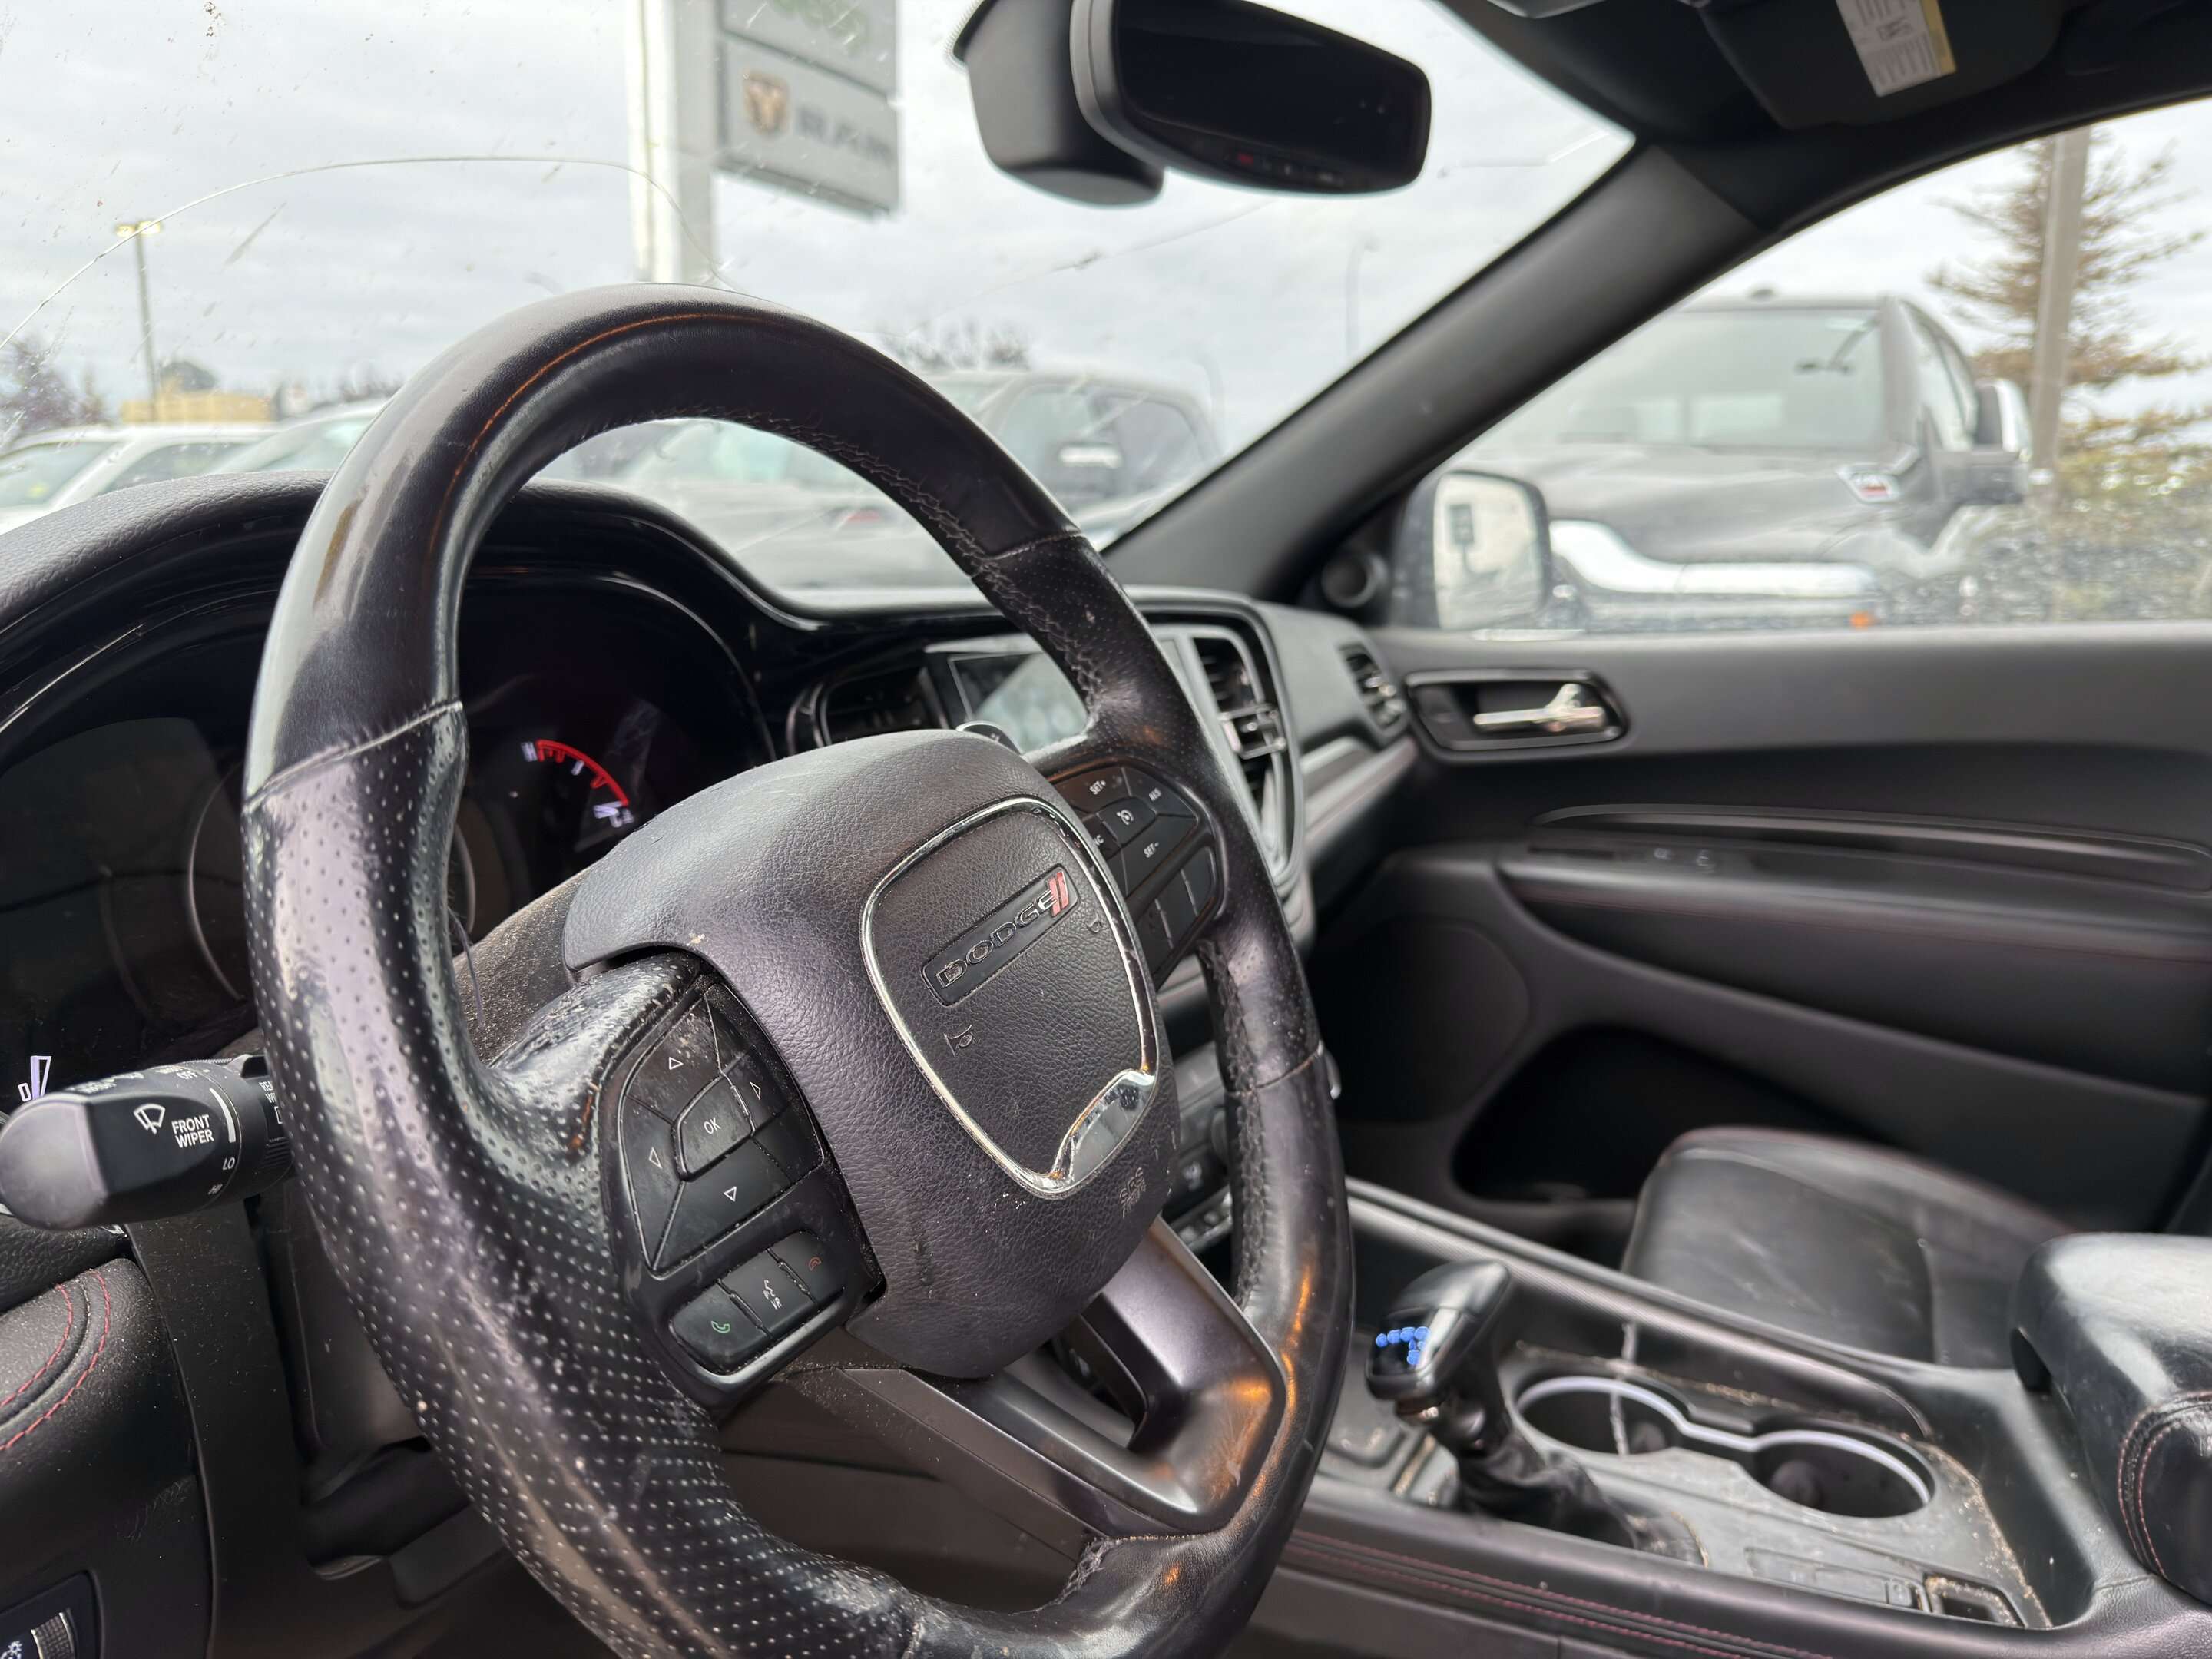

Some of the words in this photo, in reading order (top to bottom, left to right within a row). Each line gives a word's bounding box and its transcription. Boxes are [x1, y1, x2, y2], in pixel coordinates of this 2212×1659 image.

[935, 889, 1058, 988] DODGE
[171, 1114, 210, 1134] FRONT
[704, 1117, 721, 1134] OK
[175, 1130, 214, 1148] WIPER
[222, 1157, 236, 1171] LO
[770, 1296, 782, 1310] VR
